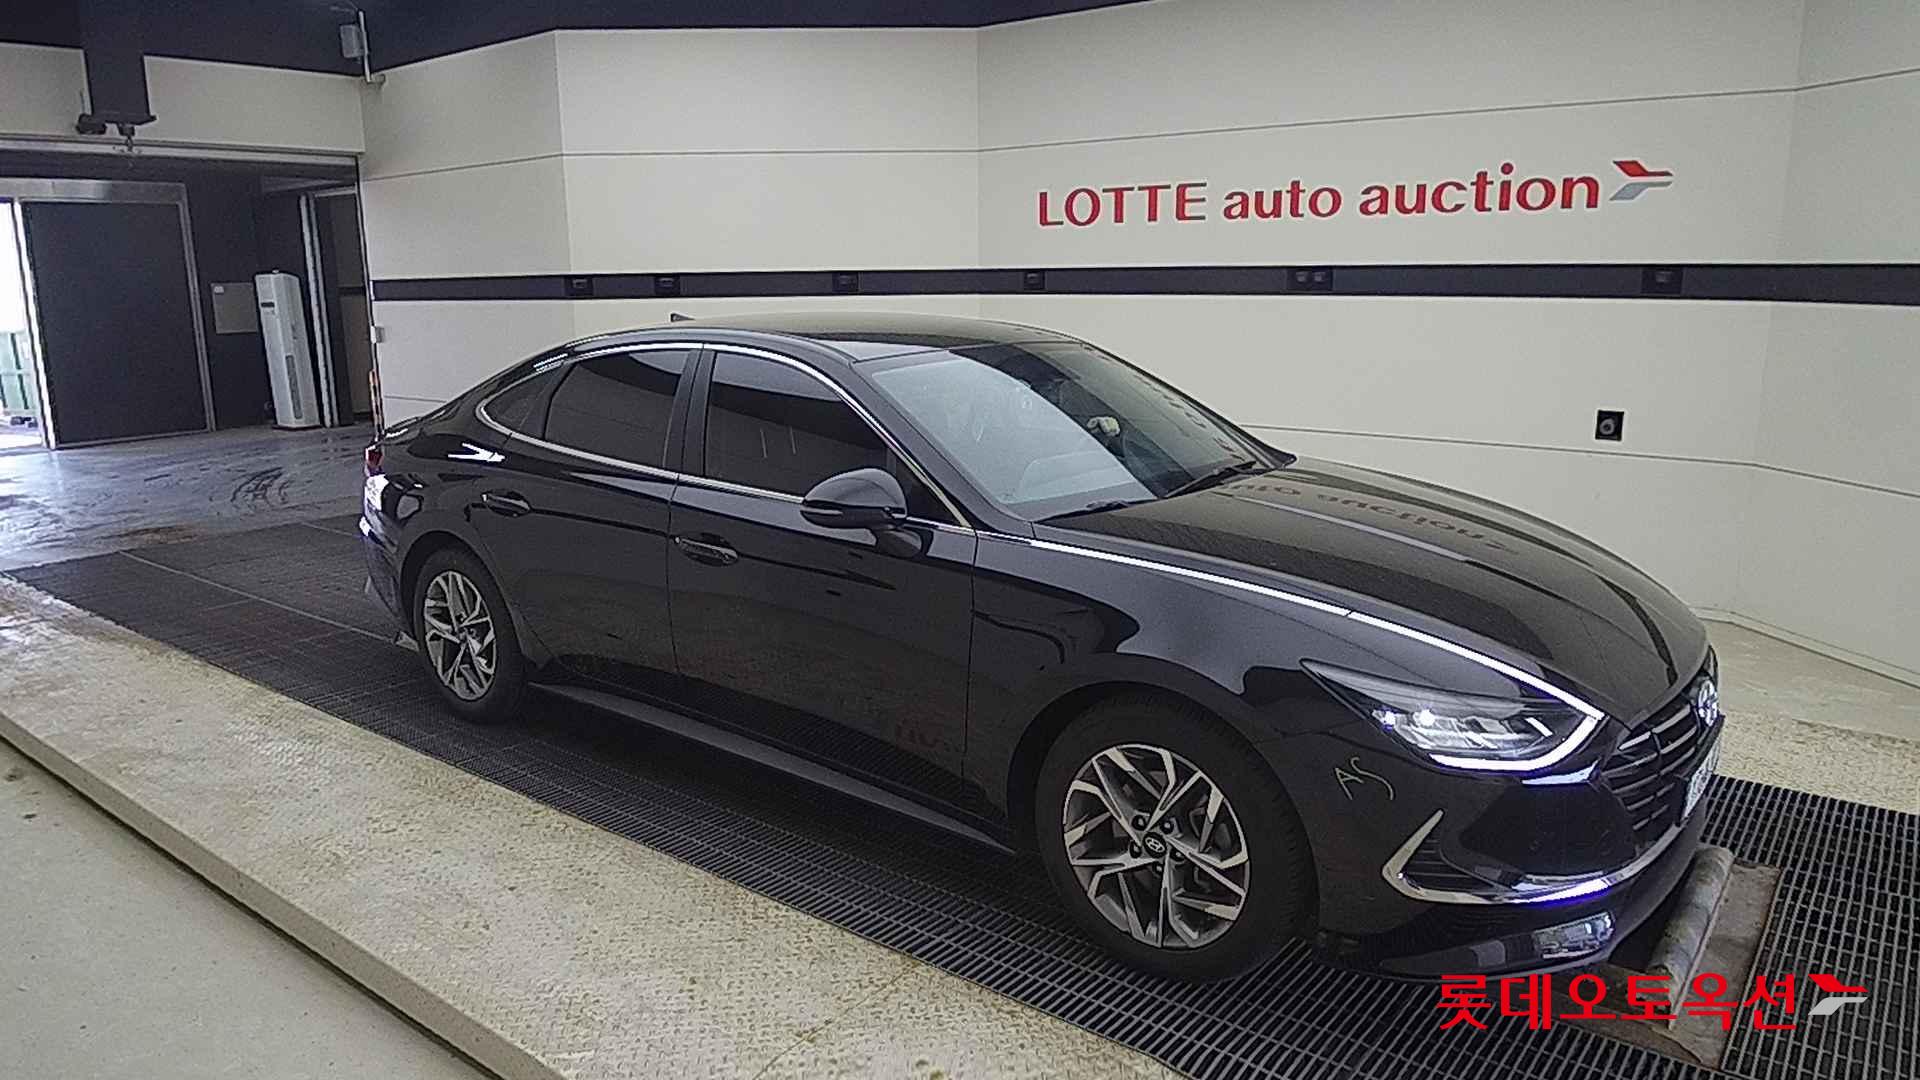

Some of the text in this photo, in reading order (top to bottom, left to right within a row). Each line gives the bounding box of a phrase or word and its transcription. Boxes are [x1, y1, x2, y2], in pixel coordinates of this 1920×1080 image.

[1039, 162, 1600, 226] LOTTE auto auction
